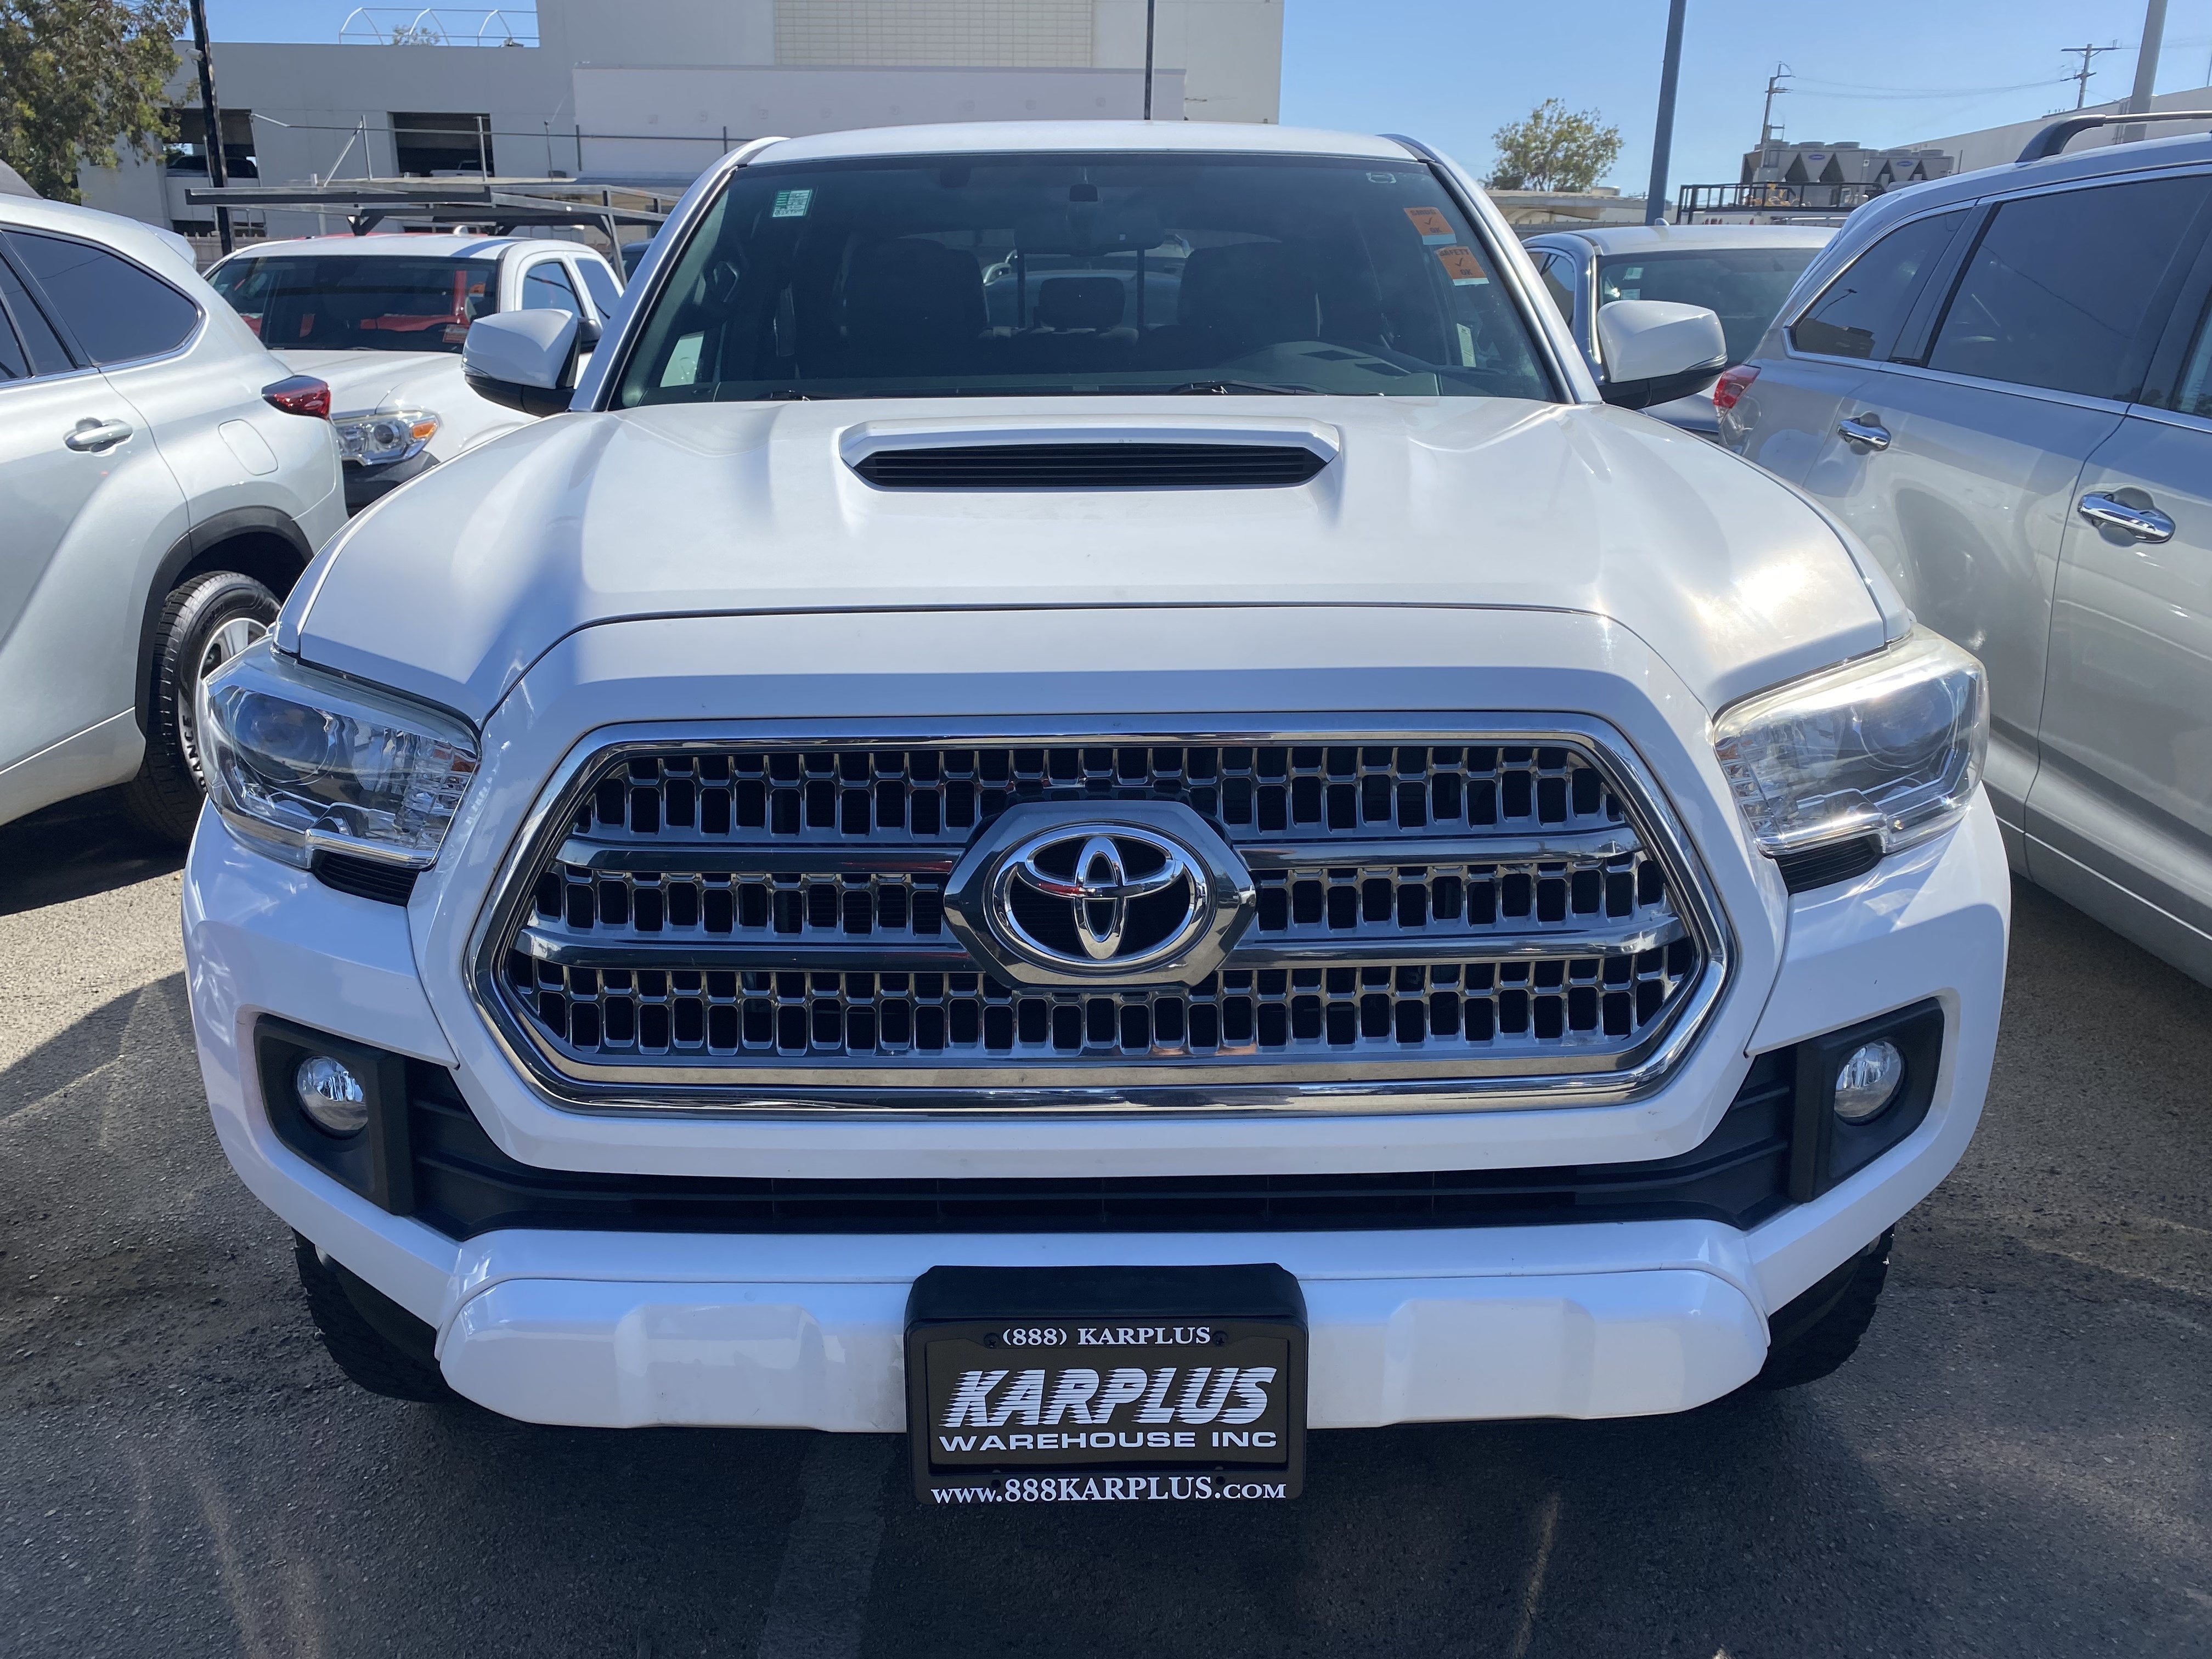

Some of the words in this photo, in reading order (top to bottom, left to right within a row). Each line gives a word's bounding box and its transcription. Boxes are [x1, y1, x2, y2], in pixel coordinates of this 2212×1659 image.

[1003, 1328, 1068, 1346] (888)
[1077, 1327, 1211, 1345] KARPLUS
[939, 1367, 1277, 1427] KARPLUS
[939, 1431, 1196, 1452] WAREHOUSE
[1212, 1431, 1277, 1448] INC
